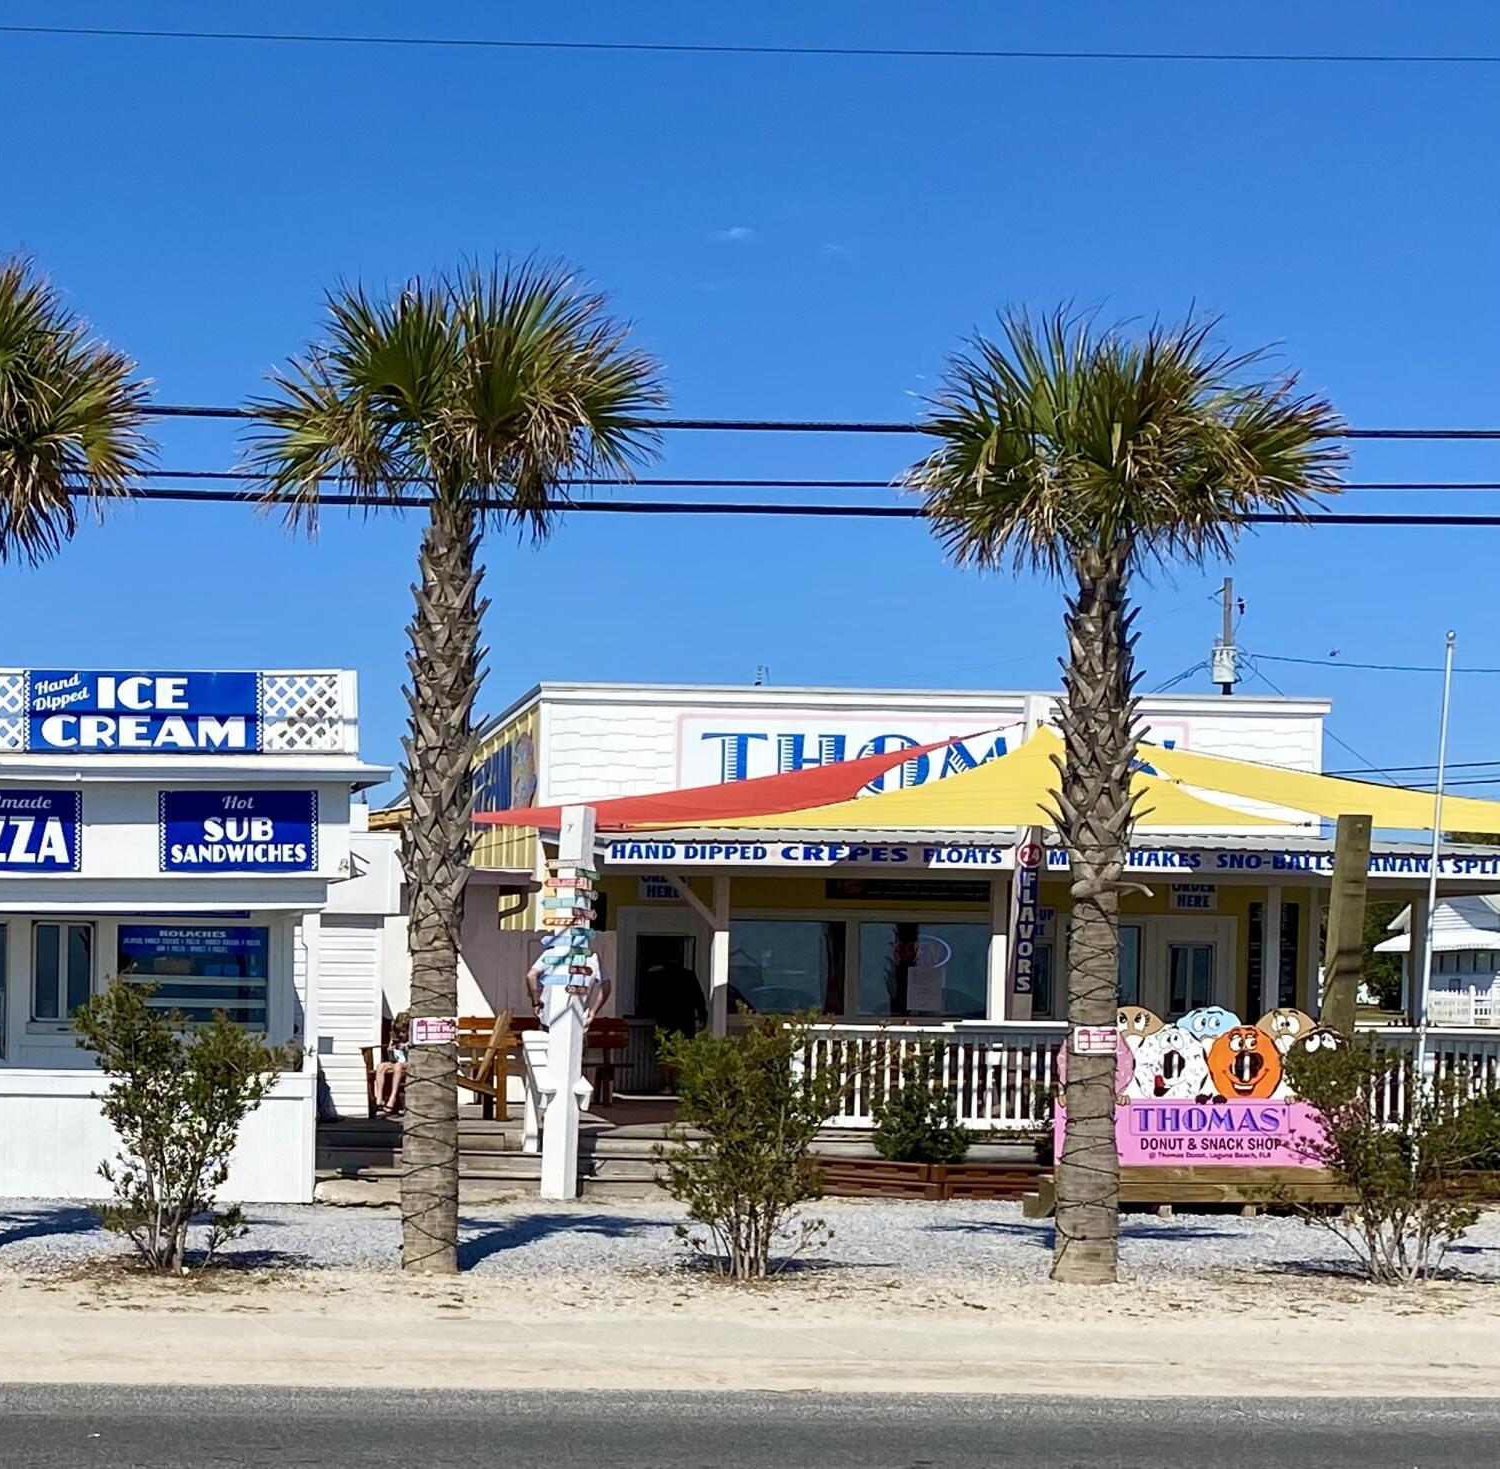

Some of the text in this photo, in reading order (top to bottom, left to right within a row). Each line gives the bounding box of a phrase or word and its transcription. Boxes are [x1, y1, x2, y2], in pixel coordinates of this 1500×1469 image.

[33, 673, 82, 694] Hand
[98, 677, 189, 710] ICE
[32, 686, 90, 712] Dipped
[41, 715, 246, 748] CREAM
[222, 795, 255, 810] Hot
[203, 817, 274, 842] SUB
[171, 842, 308, 864] SANDWICHES
[611, 844, 1002, 864] HAND DIPPED CREPES FLOATS
[1216, 853, 1335, 871] SNO-BALLS
[1368, 856, 1445, 873] ANANA
[1452, 858, 1499, 875] SPLI
[1177, 894, 1210, 908] HERE
[1016, 871, 1037, 992] FLAVORS
[1133, 1108, 1287, 1132] THOMAS'
[1140, 1137, 1281, 1151] DONUT & SNACK SHOP
